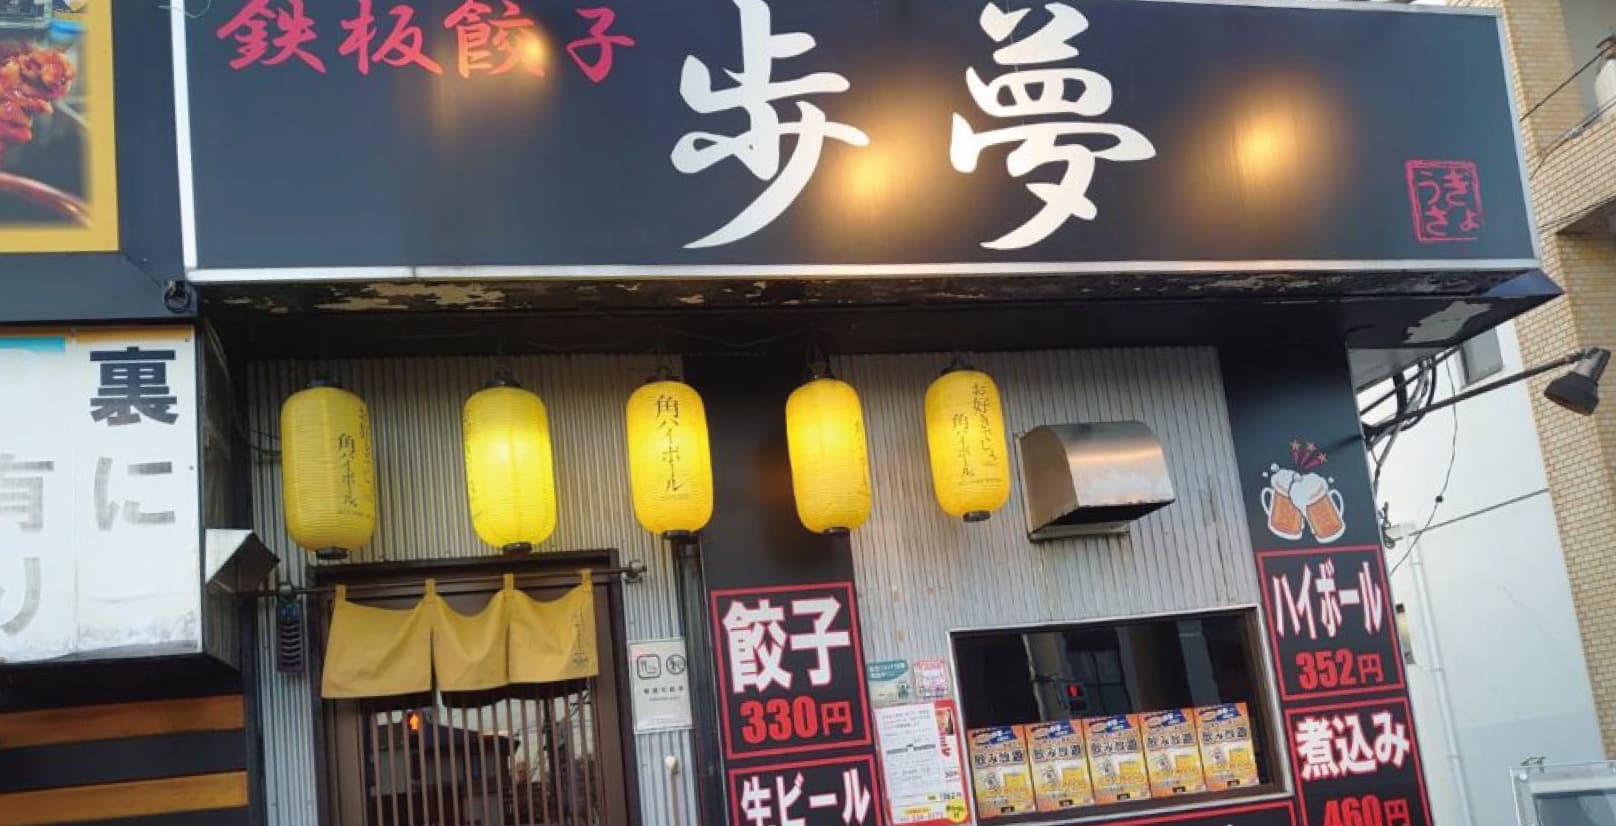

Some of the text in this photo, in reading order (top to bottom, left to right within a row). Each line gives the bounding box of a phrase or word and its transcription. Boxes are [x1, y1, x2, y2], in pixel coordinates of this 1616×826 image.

[216, 0, 635, 83] 鉄板餃子
[670, 0, 1157, 250] 歩夢
[89, 346, 179, 531] 裏に
[656, 394, 683, 492] 角ハイボール
[1271, 557, 1382, 640] ハイボール
[723, 596, 850, 694] 餃子
[1296, 648, 1384, 690] 352円
[740, 696, 853, 744] 330円
[1296, 711, 1411, 781] 煮込み
[741, 768, 871, 826] 生ビール
[1324, 795, 1410, 826] 460円
